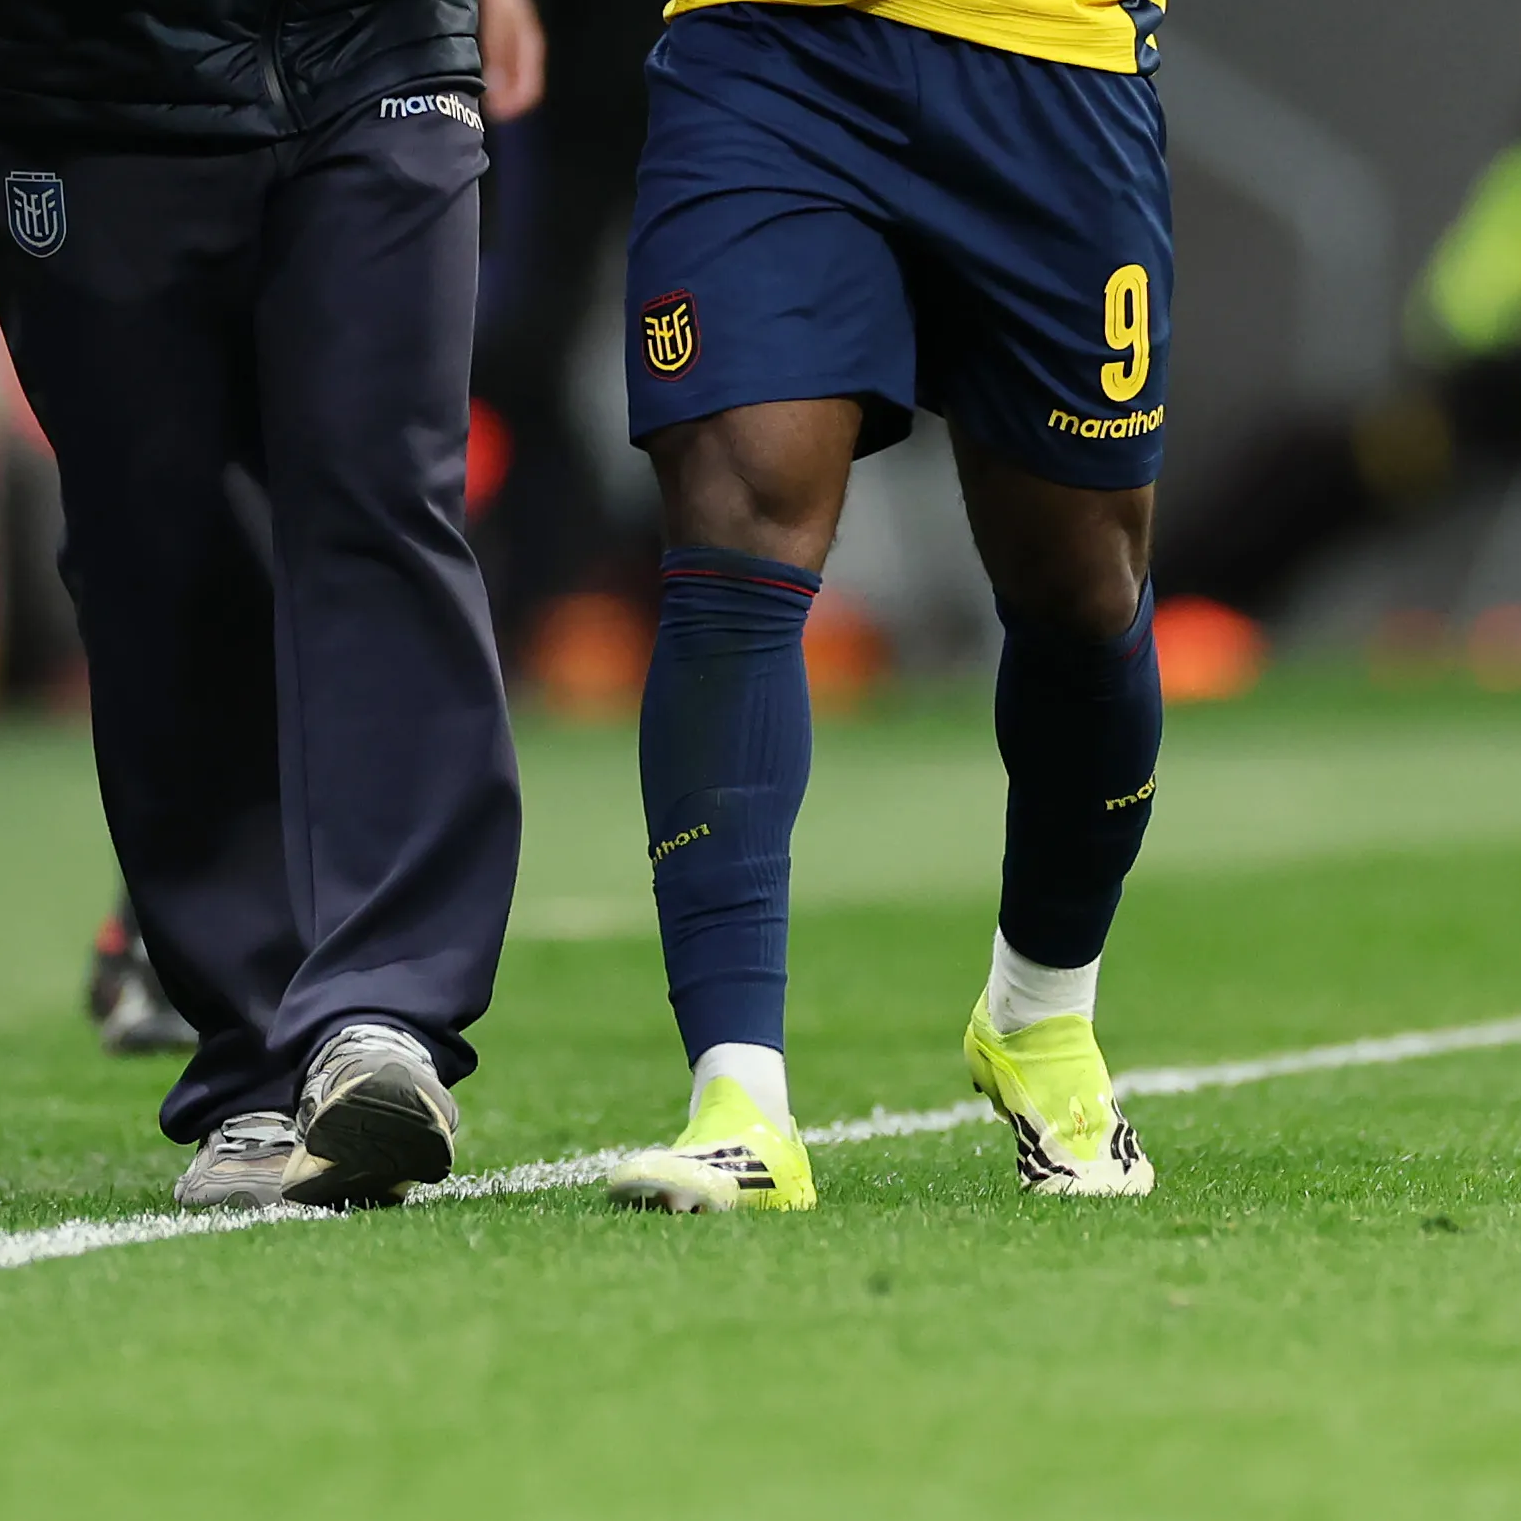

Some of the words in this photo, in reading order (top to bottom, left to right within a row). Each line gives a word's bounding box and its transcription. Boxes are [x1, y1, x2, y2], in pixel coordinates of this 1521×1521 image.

[379, 93, 485, 133] marathon
[1100, 264, 1151, 402] 9
[1047, 404, 1164, 439] marathon
